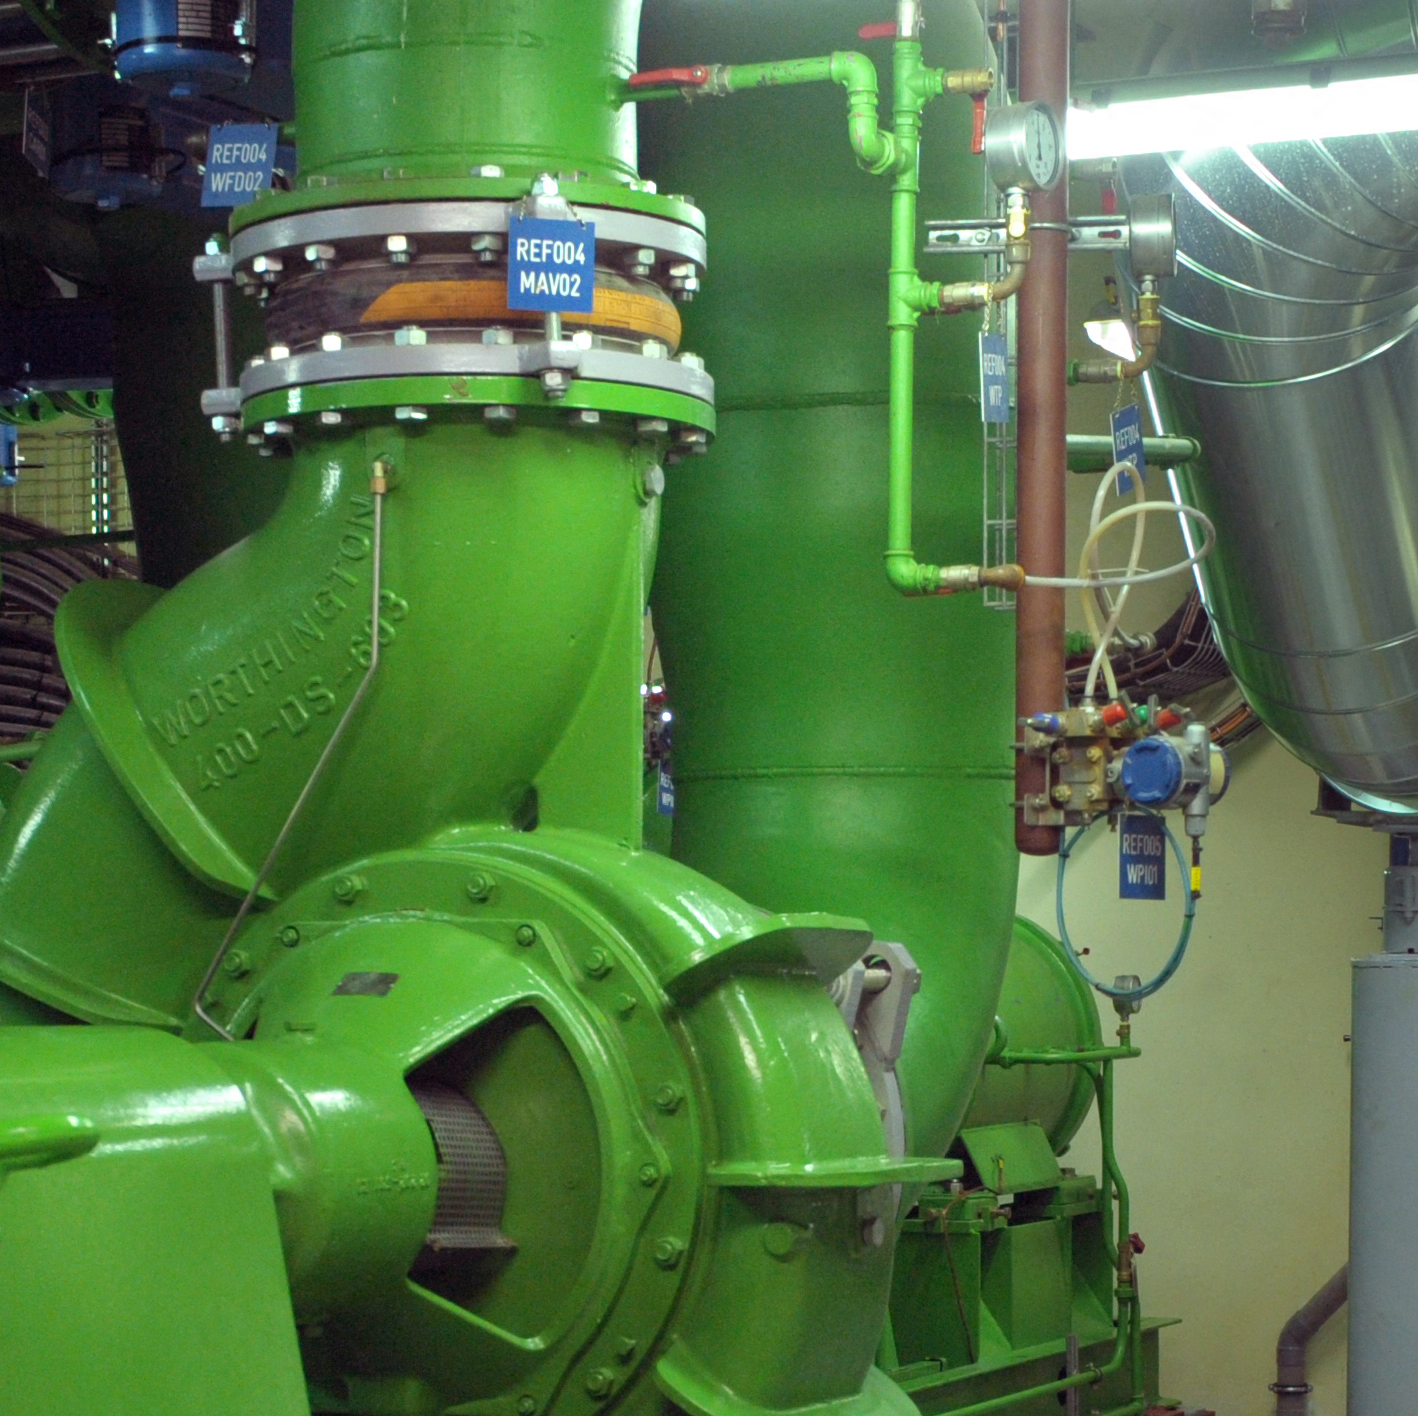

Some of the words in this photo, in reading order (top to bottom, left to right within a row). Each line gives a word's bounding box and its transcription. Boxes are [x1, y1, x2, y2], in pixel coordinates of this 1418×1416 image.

[212, 142, 267, 164] REF004
[210, 170, 264, 192] WFD02
[516, 237, 586, 265] REF004
[519, 270, 581, 298] MAV02
[983, 353, 1006, 377] REF004
[988, 384, 1003, 406] WTP
[151, 494, 375, 749] WORTHINGTON
[1122, 833, 1162, 856] REF005
